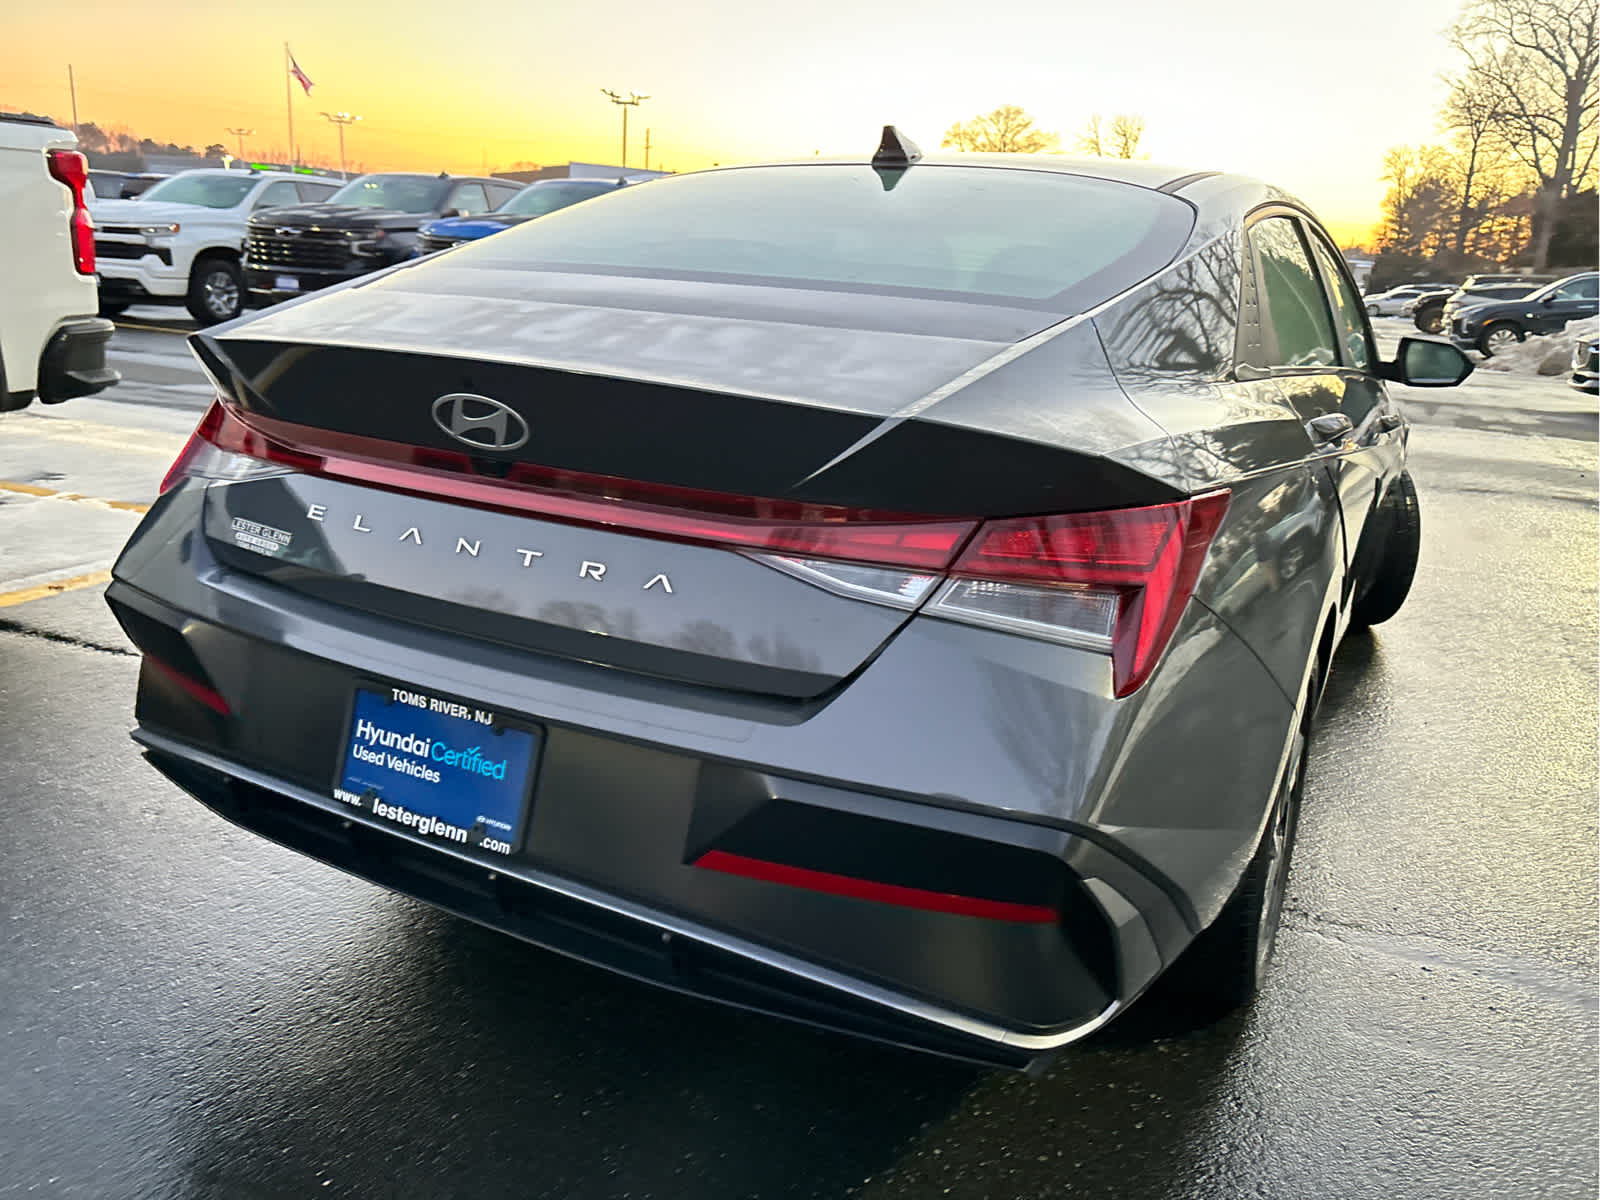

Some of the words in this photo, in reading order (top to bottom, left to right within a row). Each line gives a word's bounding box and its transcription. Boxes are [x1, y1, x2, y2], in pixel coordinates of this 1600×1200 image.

[232, 519, 261, 535] LESTER
[306, 503, 673, 594] ELANTRA
[392, 688, 428, 709] TOMS
[429, 698, 472, 721] RIVER,
[474, 709, 493, 726] NJ
[352, 744, 385, 766] Used
[387, 753, 441, 784] Vehicles
[355, 718, 431, 758] Hyundai
[431, 741, 507, 780] Certified
[333, 788, 362, 807] www.
[372, 798, 468, 843] lesterglenn
[479, 836, 511, 855] .com
